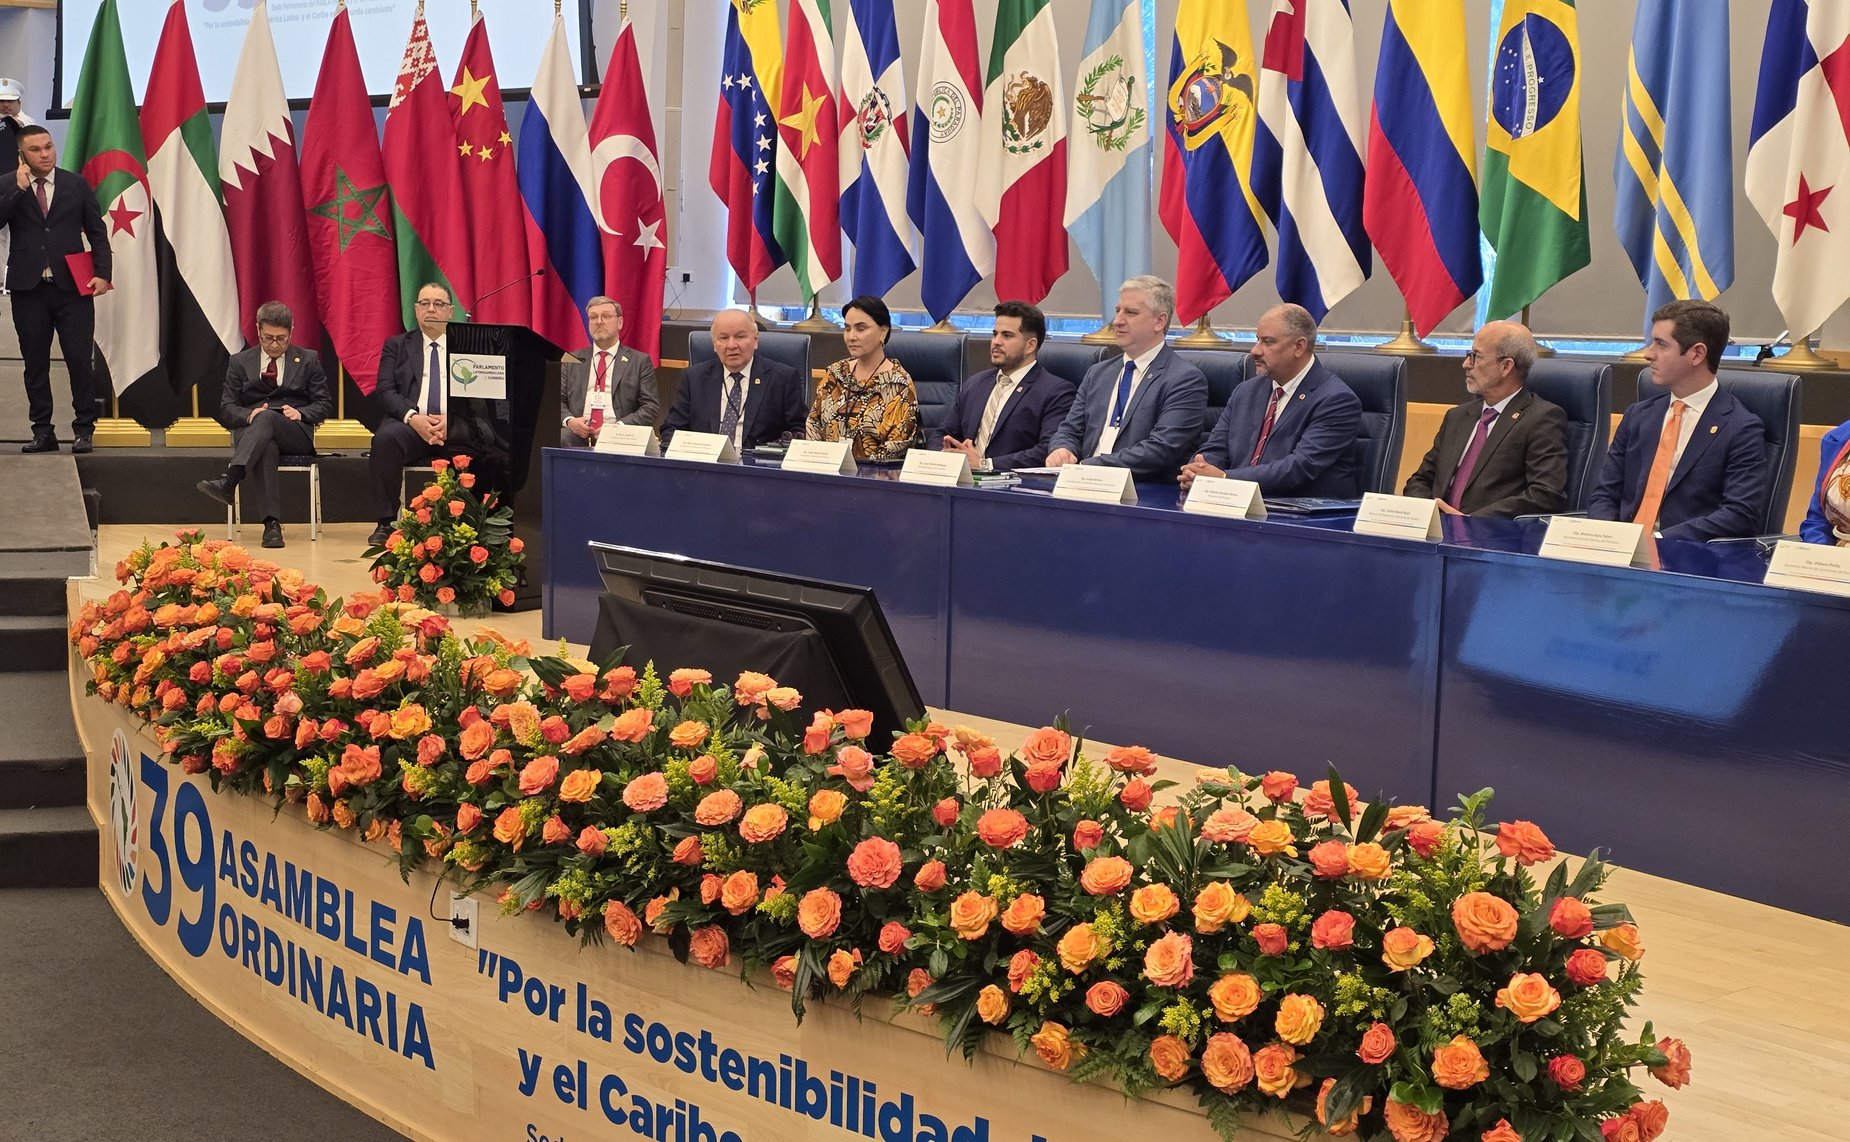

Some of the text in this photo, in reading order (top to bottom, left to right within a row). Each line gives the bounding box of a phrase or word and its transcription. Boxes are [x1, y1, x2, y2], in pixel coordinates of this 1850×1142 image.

[1526, 64, 1535, 129] PROGRESSO
[140, 751, 216, 958] 39
[218, 829, 432, 986] ASAMBLEA
[218, 902, 436, 1071] ORDINARIA
[478, 947, 566, 1023] "Por
[576, 981, 612, 1043] la
[517, 1047, 543, 1097] y
[552, 1059, 588, 1111] el
